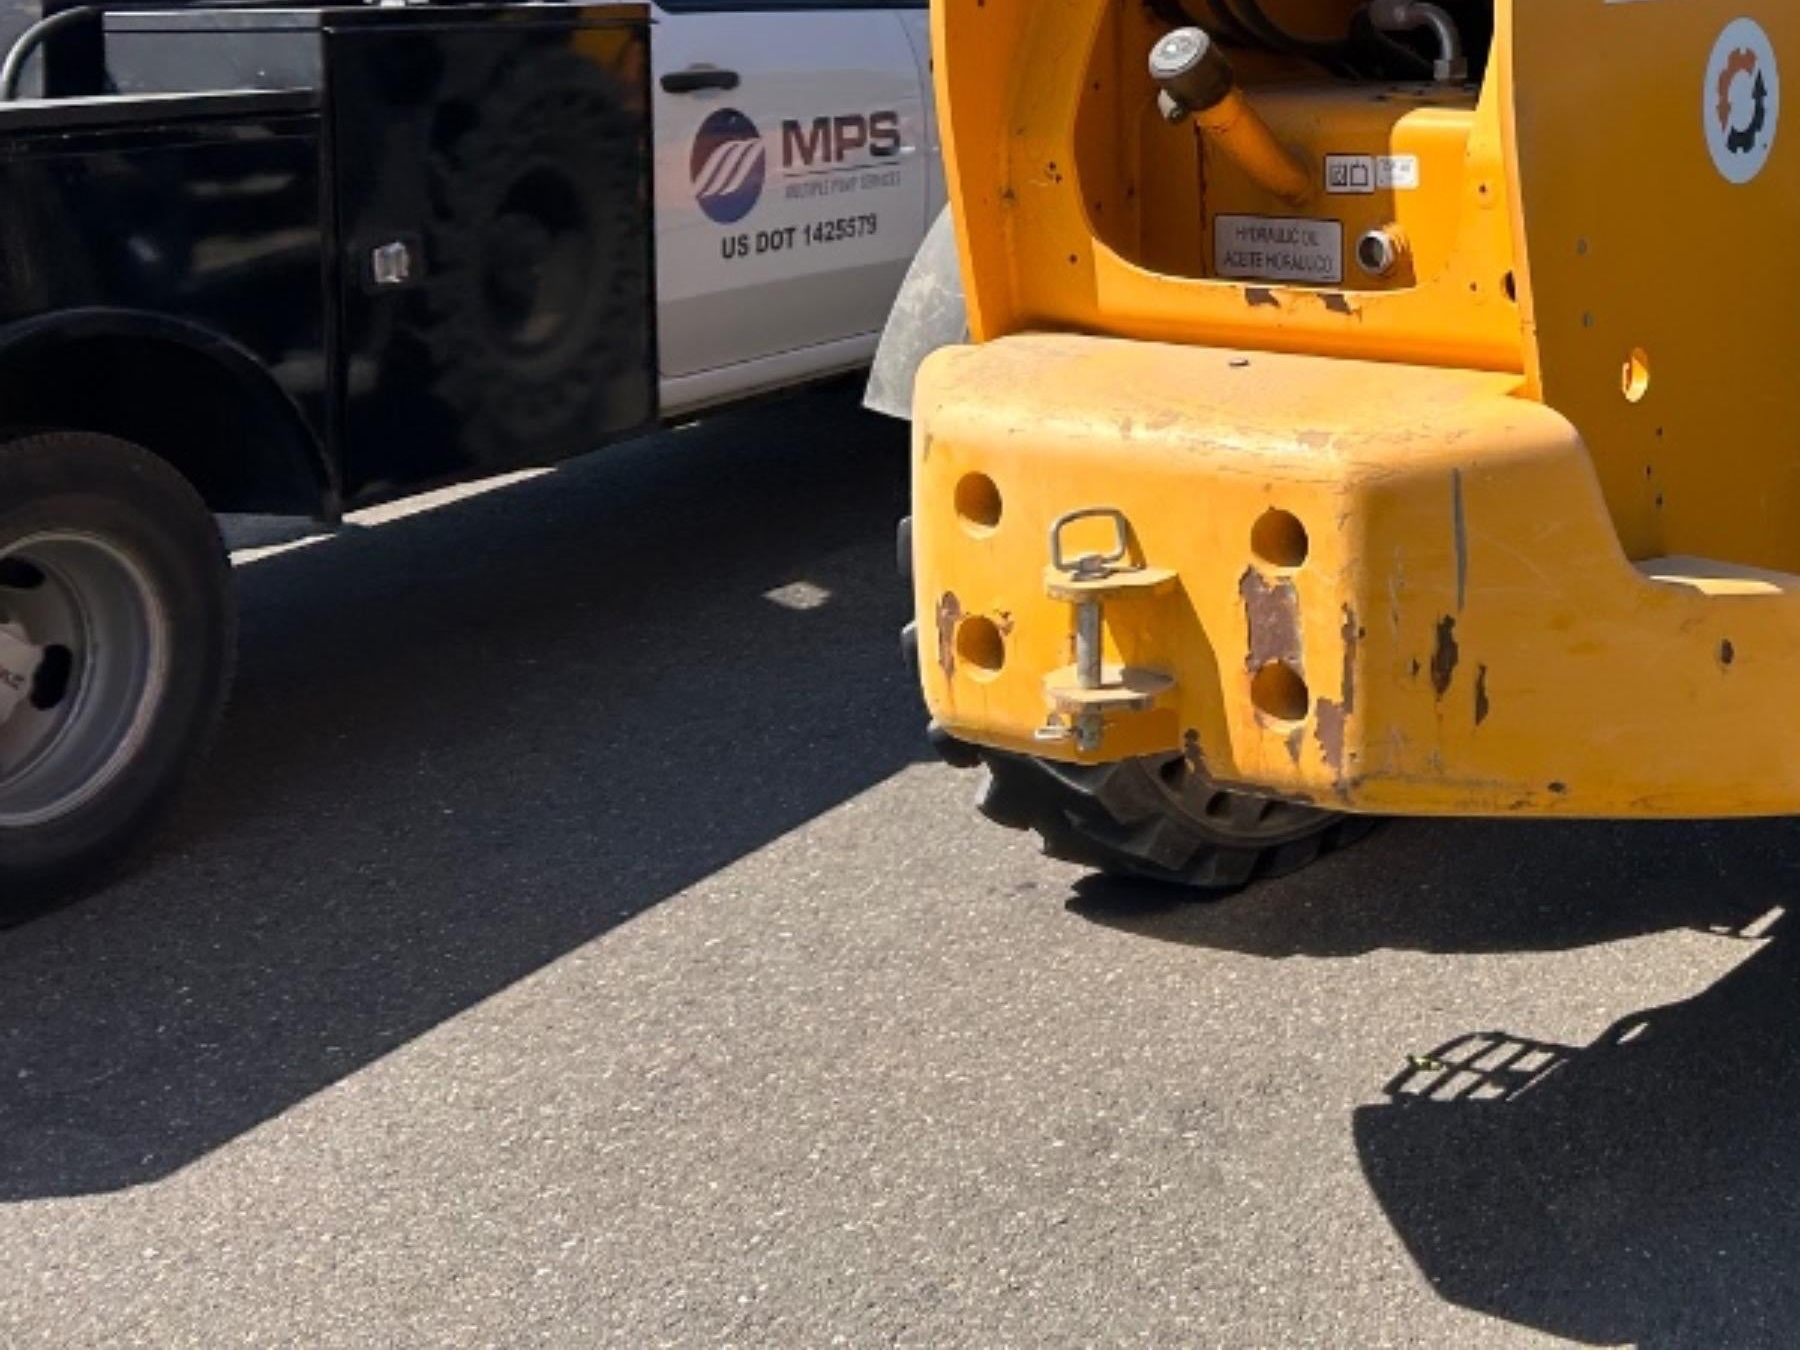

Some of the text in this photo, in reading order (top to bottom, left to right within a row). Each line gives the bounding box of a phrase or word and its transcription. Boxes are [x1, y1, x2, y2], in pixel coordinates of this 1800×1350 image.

[781, 110, 901, 169] MPS
[722, 212, 877, 259] US DOT 1425579
